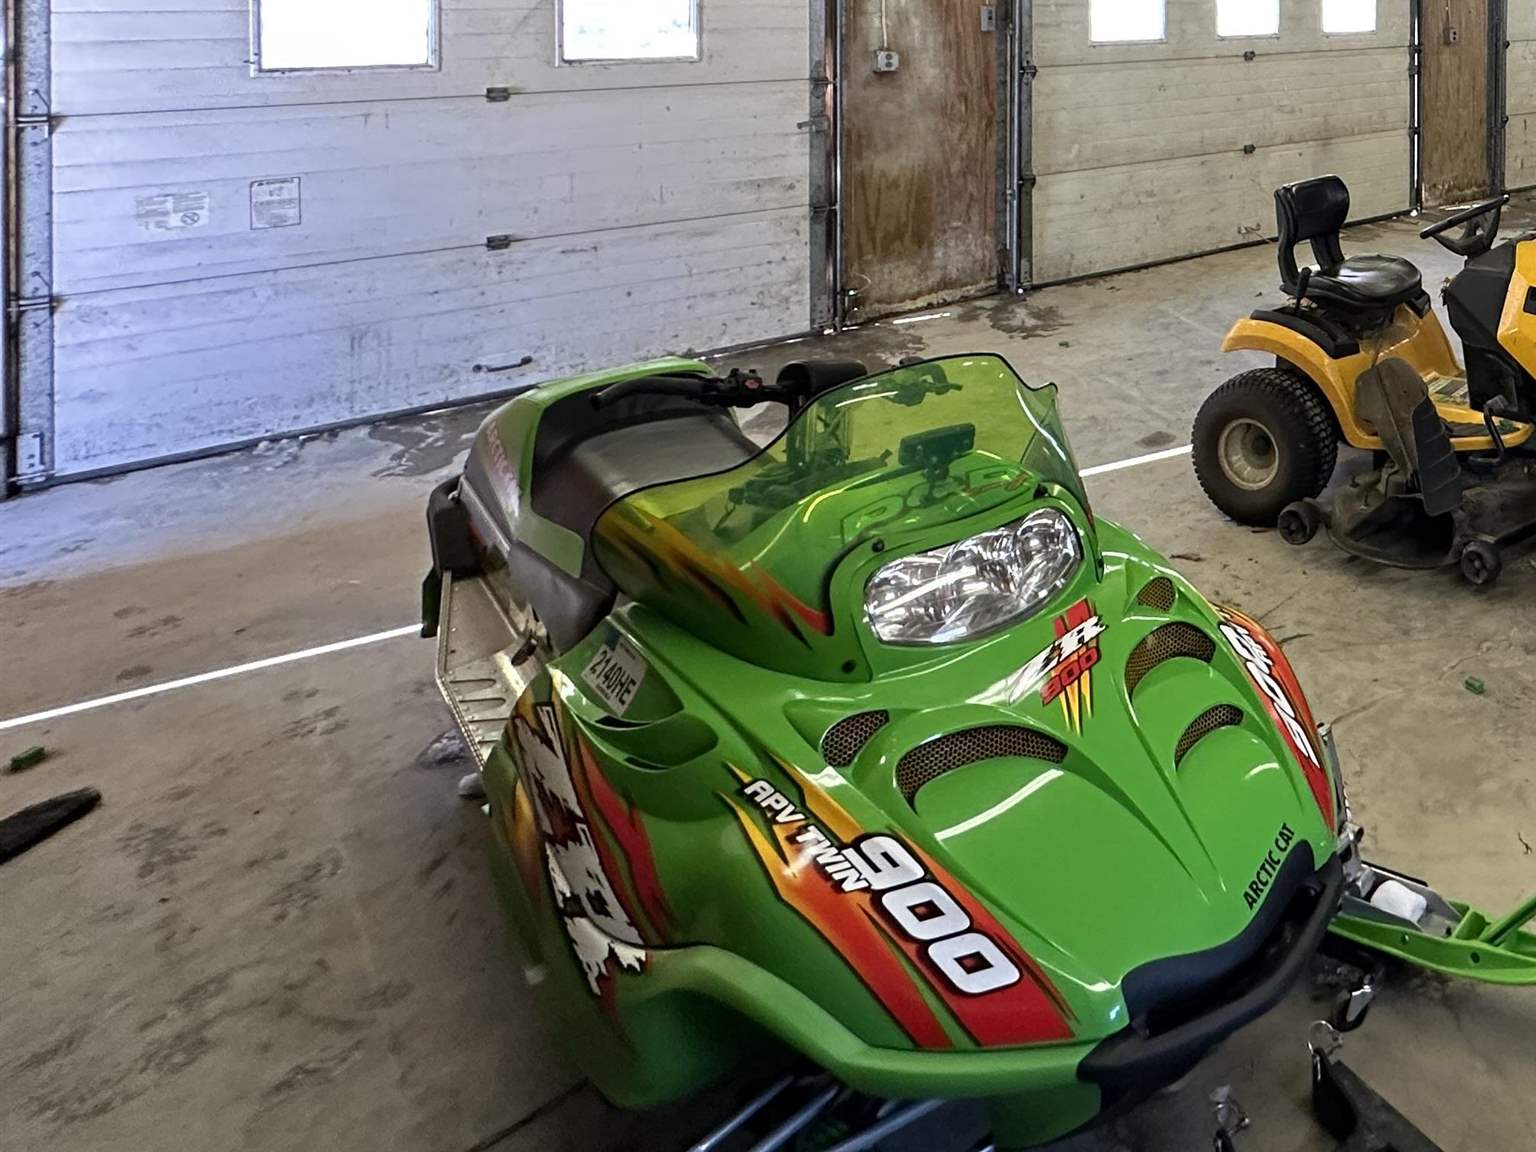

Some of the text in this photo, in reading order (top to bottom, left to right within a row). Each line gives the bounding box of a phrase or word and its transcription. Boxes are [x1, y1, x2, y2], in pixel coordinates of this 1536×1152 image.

[1039, 646, 1101, 707] 900
[743, 779, 869, 893] APV TWIN
[1242, 821, 1295, 911] ARCTIC CAT
[843, 834, 1022, 995] 900
